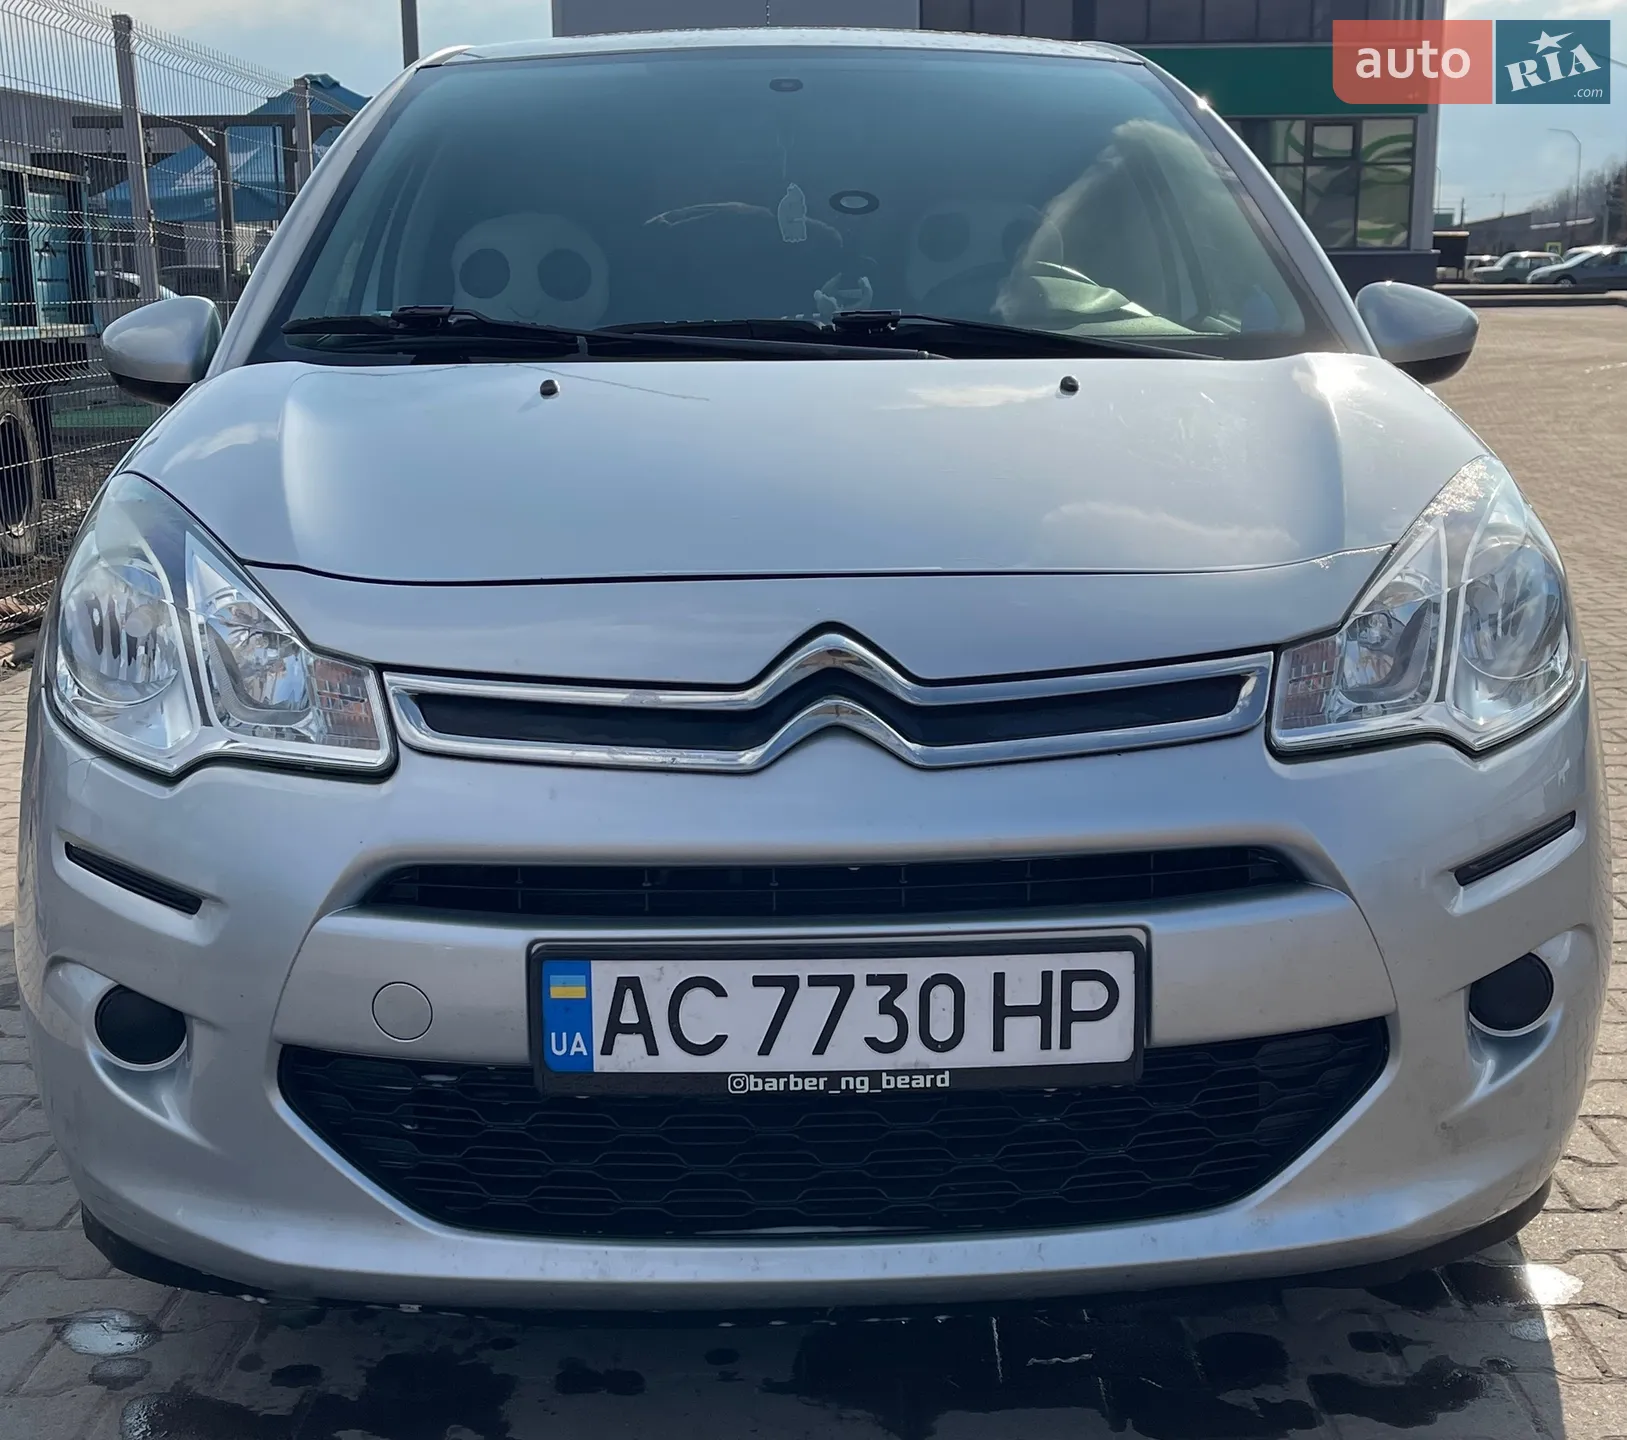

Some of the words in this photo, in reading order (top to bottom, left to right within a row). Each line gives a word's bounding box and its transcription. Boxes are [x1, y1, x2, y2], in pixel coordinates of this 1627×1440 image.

[600, 975, 729, 1056] AC
[752, 972, 966, 1056] 7730
[992, 969, 1120, 1052] HP
[551, 1032, 588, 1056] UA
[749, 1070, 950, 1094] barber_ng_beard
